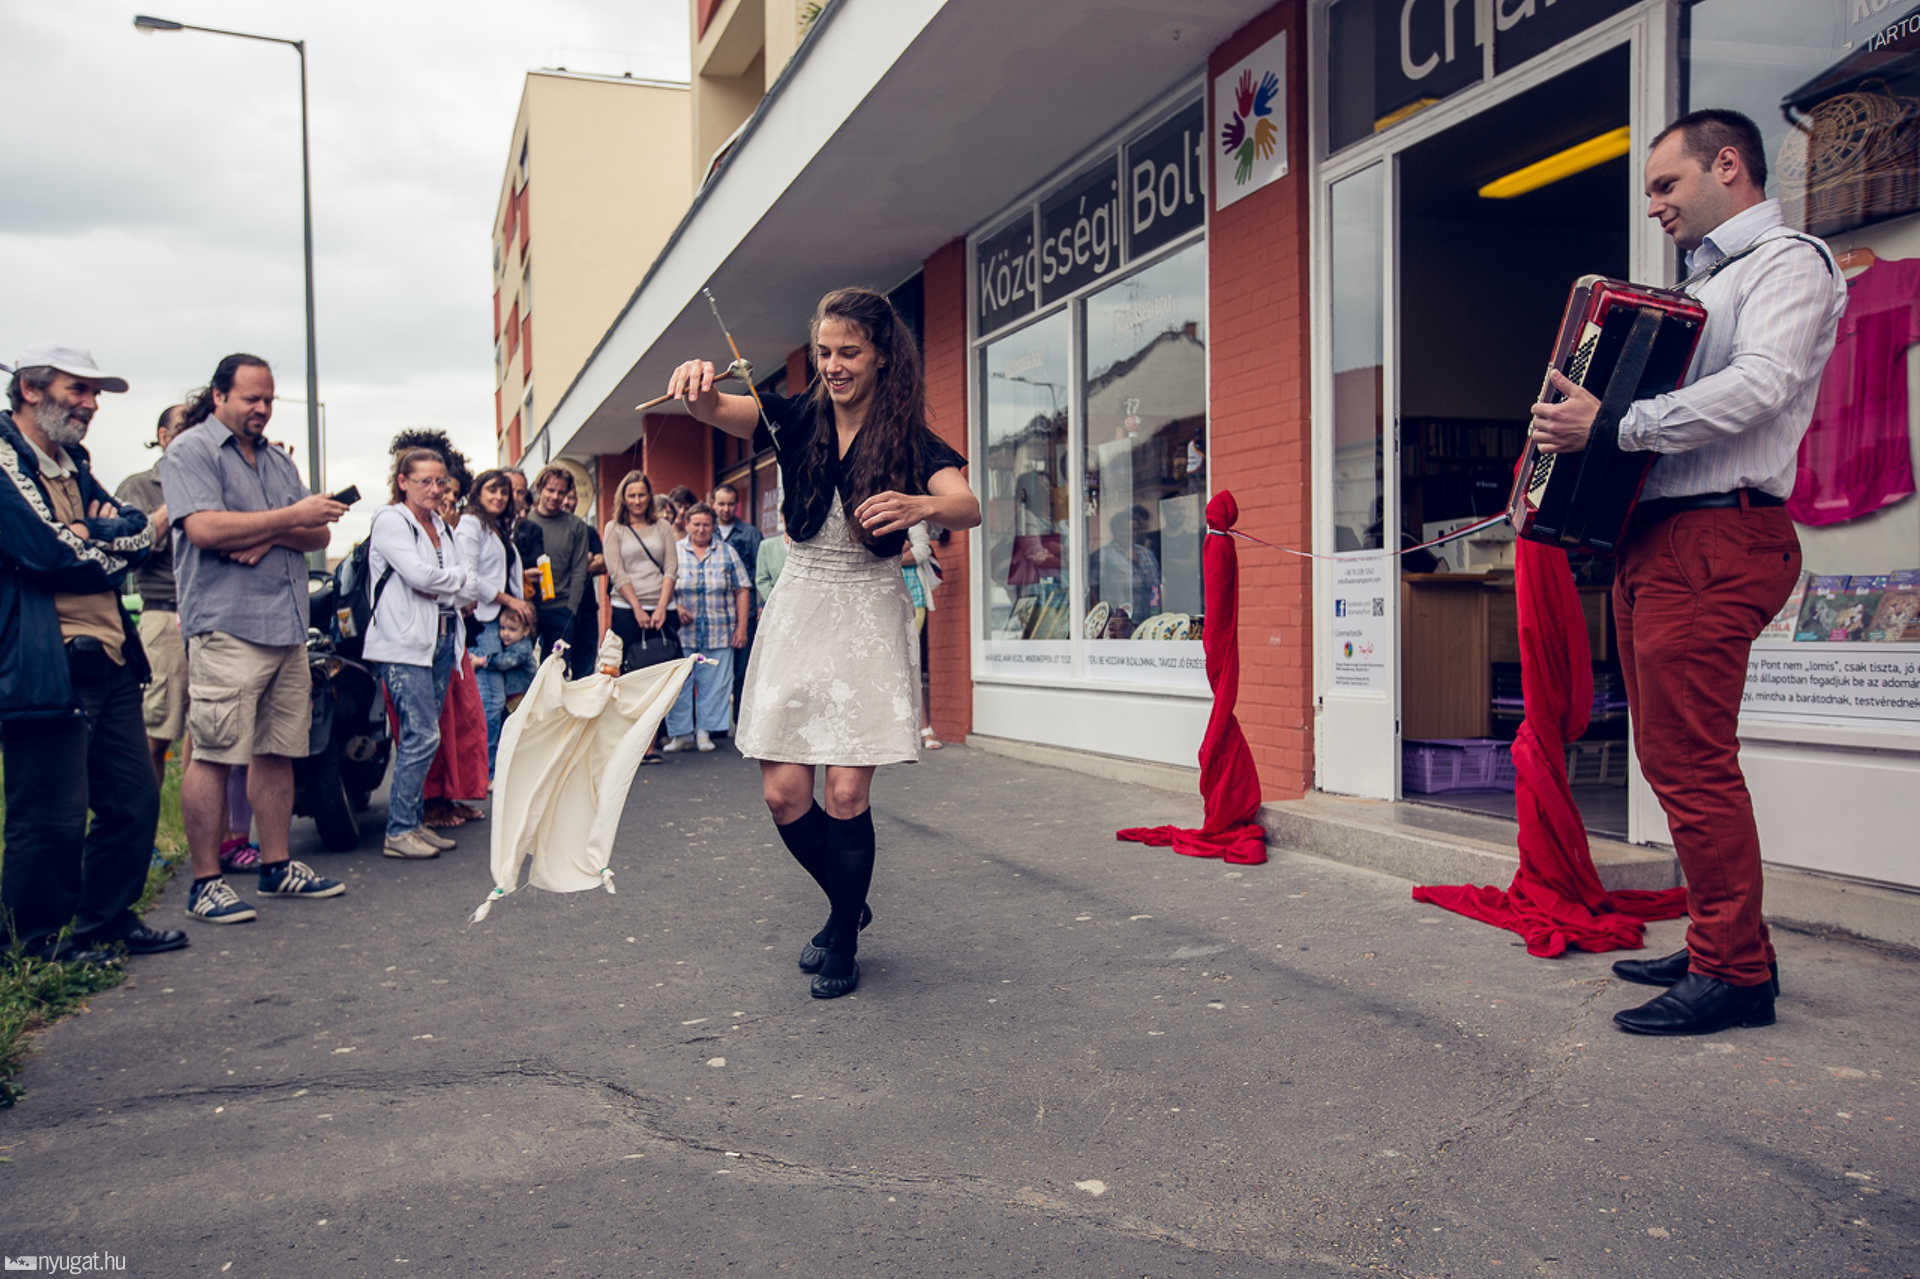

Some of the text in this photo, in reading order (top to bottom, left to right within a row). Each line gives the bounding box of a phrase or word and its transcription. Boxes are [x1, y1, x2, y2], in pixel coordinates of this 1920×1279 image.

[981, 130, 1207, 317] Közösségi Bolt
[1760, 659, 1780, 670] Pont
[1783, 662, 1802, 671] nem
[1844, 661, 1866, 672] csak
[1904, 662, 1915, 676] jó
[1760, 673, 1807, 686] állapotban
[1809, 675, 1849, 688] fogadjuk
[1852, 676, 1865, 687] be
[1867, 679, 1879, 687] az
[1756, 691, 1786, 702] mintha
[1788, 694, 1794, 702] a
[1796, 692, 1852, 706] barátodnak,
